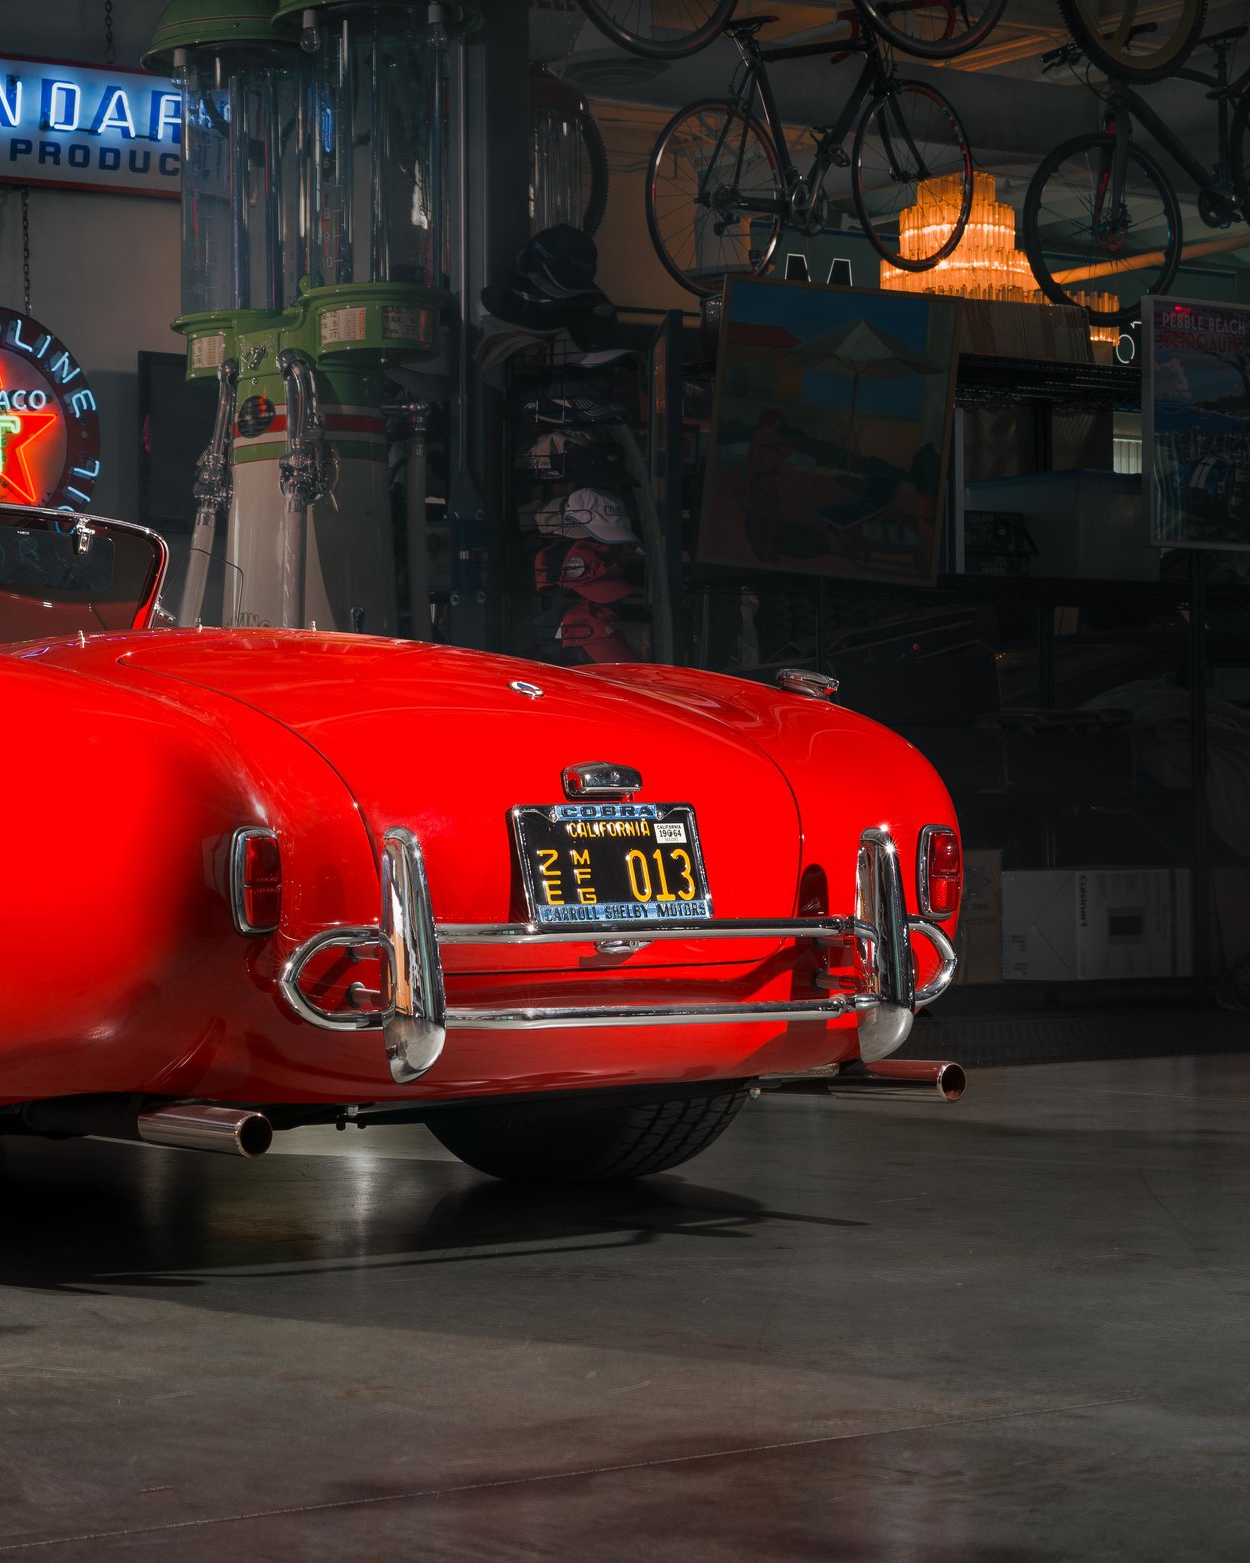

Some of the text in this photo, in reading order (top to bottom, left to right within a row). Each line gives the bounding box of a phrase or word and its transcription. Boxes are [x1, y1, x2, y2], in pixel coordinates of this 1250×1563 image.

[1162, 312, 1246, 335] PEBBLE BEACH
[561, 805, 654, 818] COBRA
[567, 819, 651, 838] CALIFORNIA
[626, 848, 696, 902] 013
[543, 902, 707, 922] CARROLL SHELBY MOTORS
[1079, 875, 1088, 928] Cuisinart
